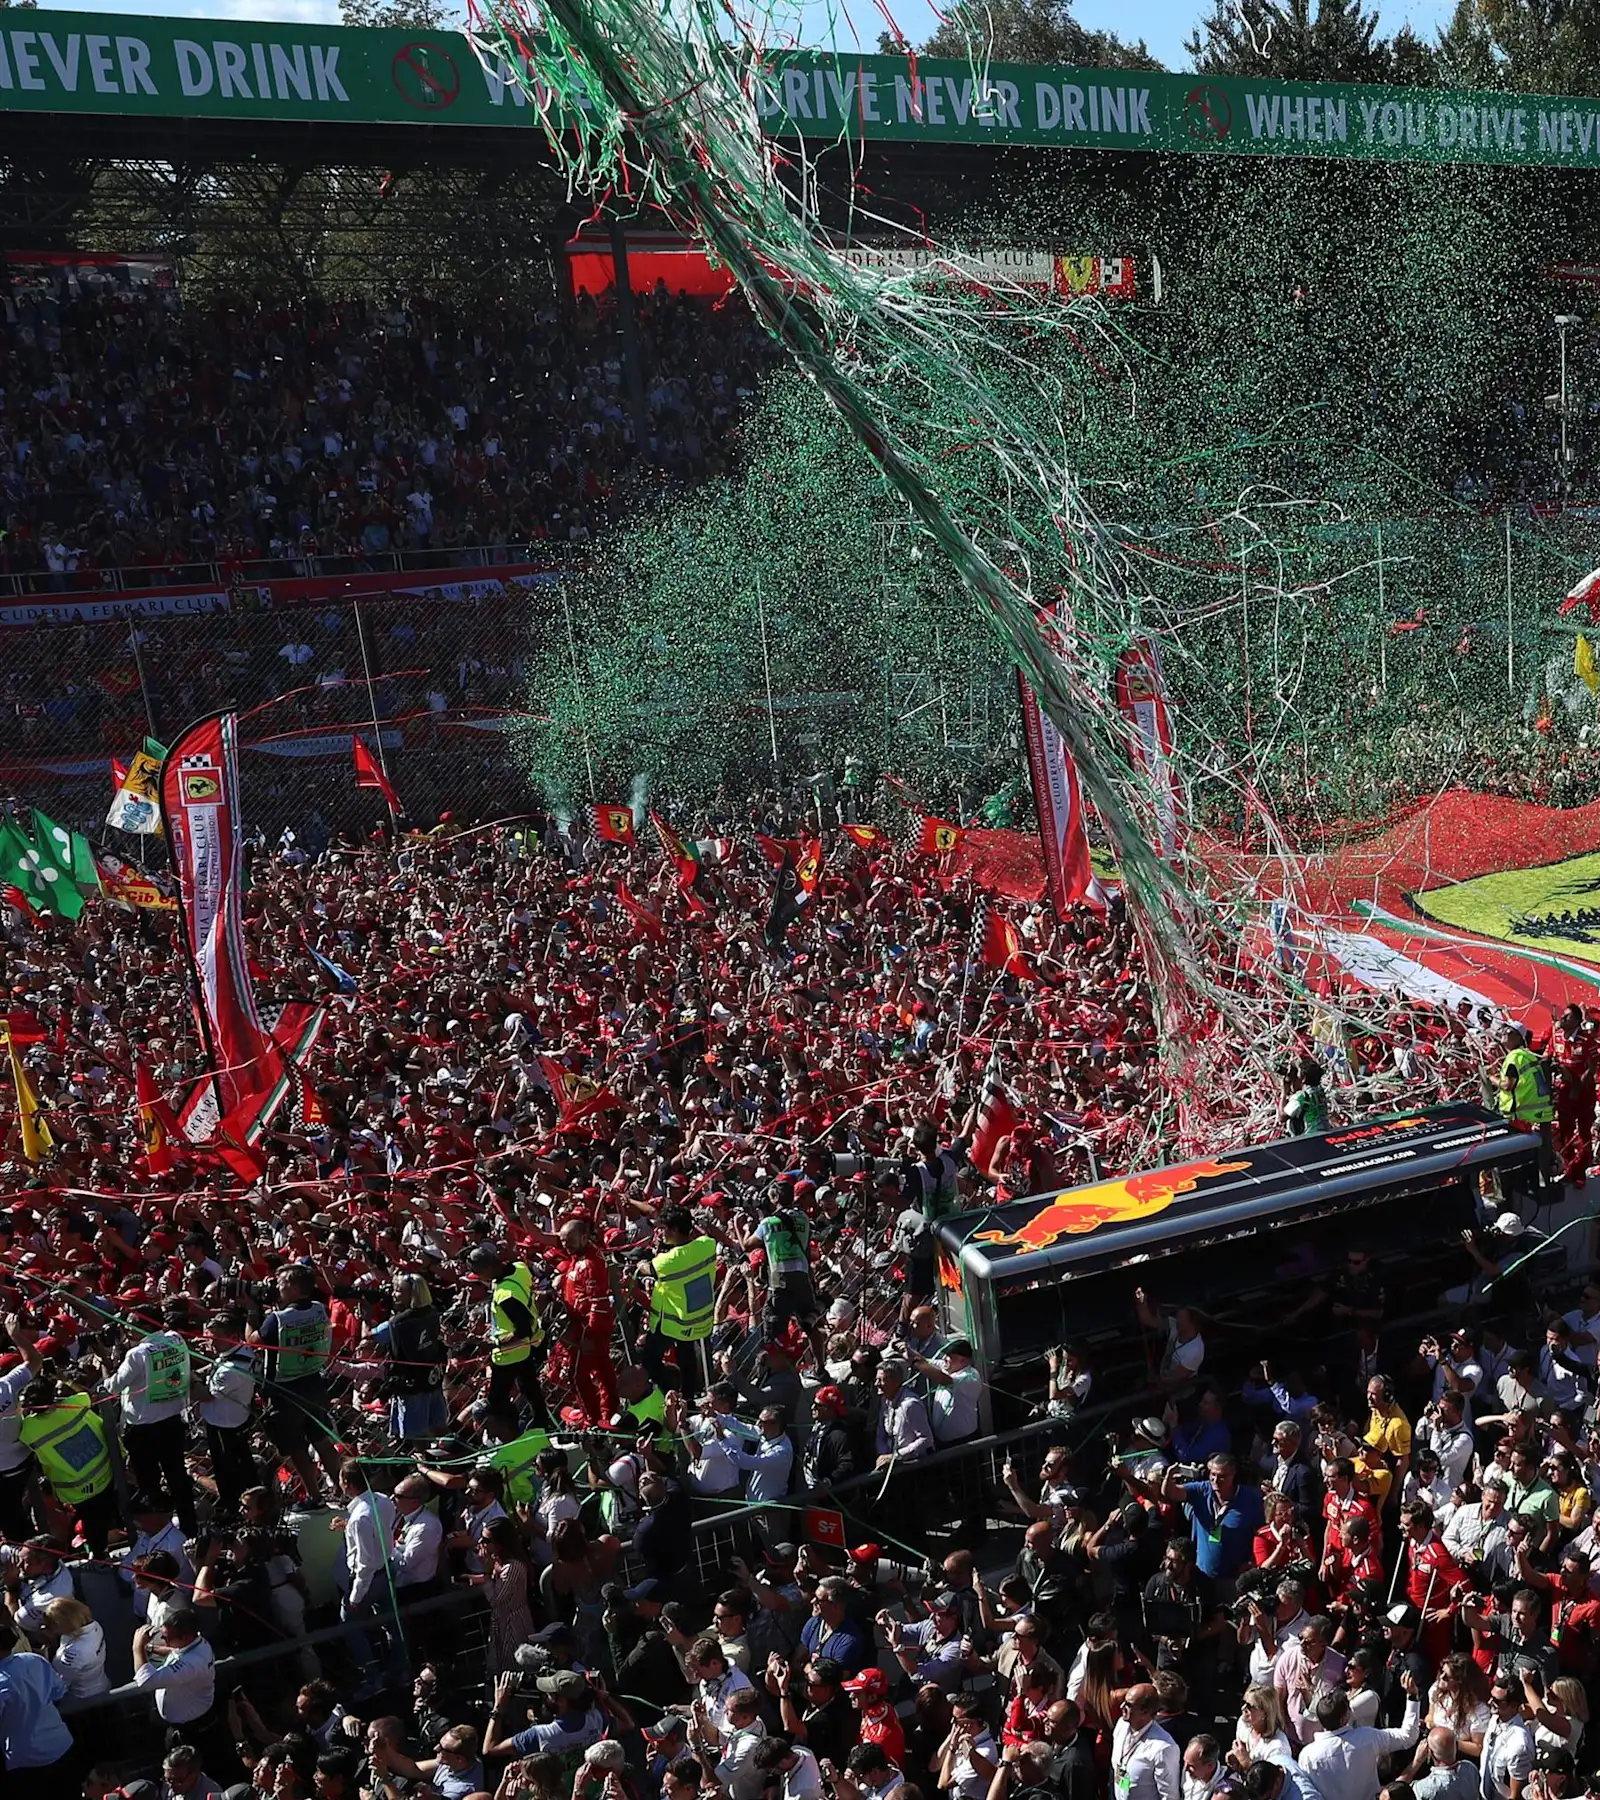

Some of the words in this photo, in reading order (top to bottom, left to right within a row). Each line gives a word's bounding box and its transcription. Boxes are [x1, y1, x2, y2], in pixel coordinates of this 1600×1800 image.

[173, 39, 350, 101] DRINK
[894, 73, 1022, 128] NEVER
[1035, 82, 1153, 134] DRINK
[1245, 93, 1347, 143] WHEN
[1359, 100, 1426, 146] YOU
[1438, 104, 1527, 151] DRIVE
[0, 606, 82, 621] CUDERIA
[174, 597, 219, 611] CLUB
[1048, 758, 1063, 811] SCUDERIA
[194, 814, 206, 849] CLUB
[208, 815, 216, 849] Passion
[199, 855, 209, 910] FERRARI
[1325, 1131, 1354, 1145] Red
[1354, 1125, 1387, 1141] Bull
[1334, 1121, 1438, 1149] RACING
[1319, 1150, 1417, 1177] REDBULLRACING.COM
